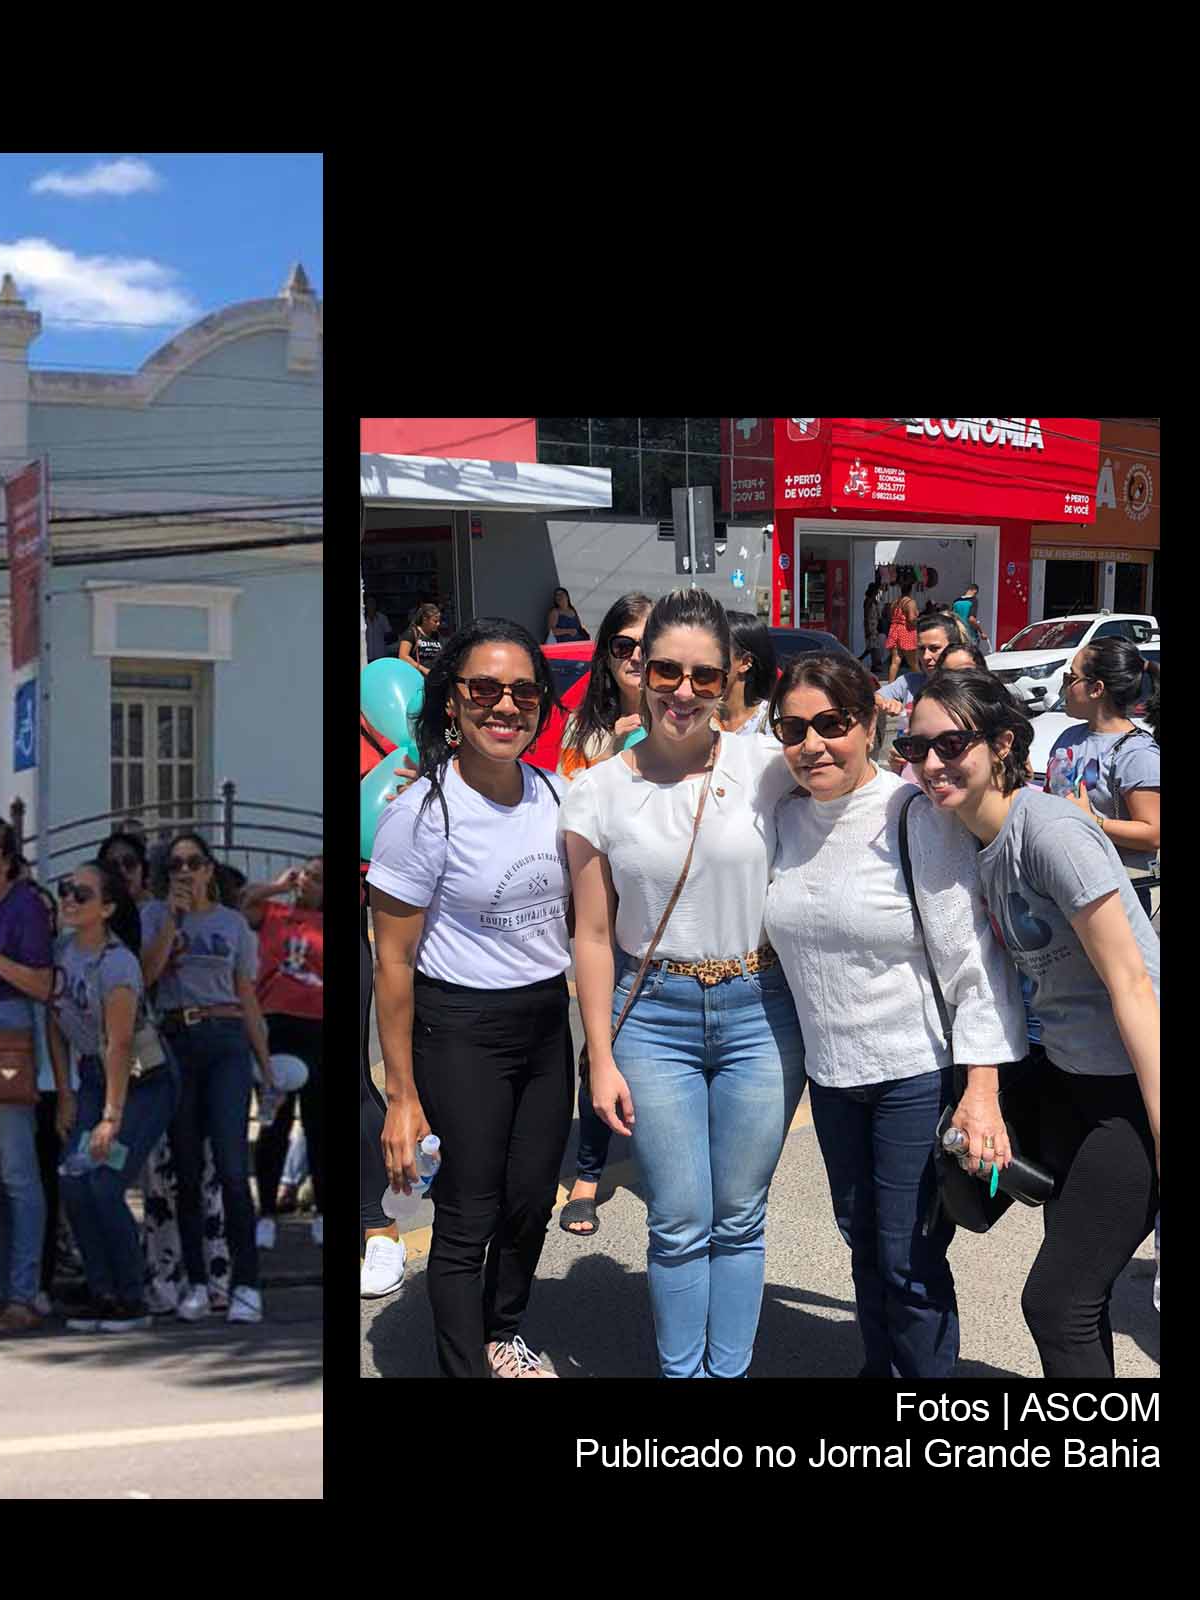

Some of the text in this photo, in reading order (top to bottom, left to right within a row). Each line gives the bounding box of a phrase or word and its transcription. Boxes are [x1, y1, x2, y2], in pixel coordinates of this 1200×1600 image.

[793, 474, 821, 485] PERTO
[785, 485, 822, 499] DE VOCÊ
[1071, 494, 1089, 504] PERTO
[1064, 505, 1072, 514] DE
[480, 914, 512, 927] EQUIPE
